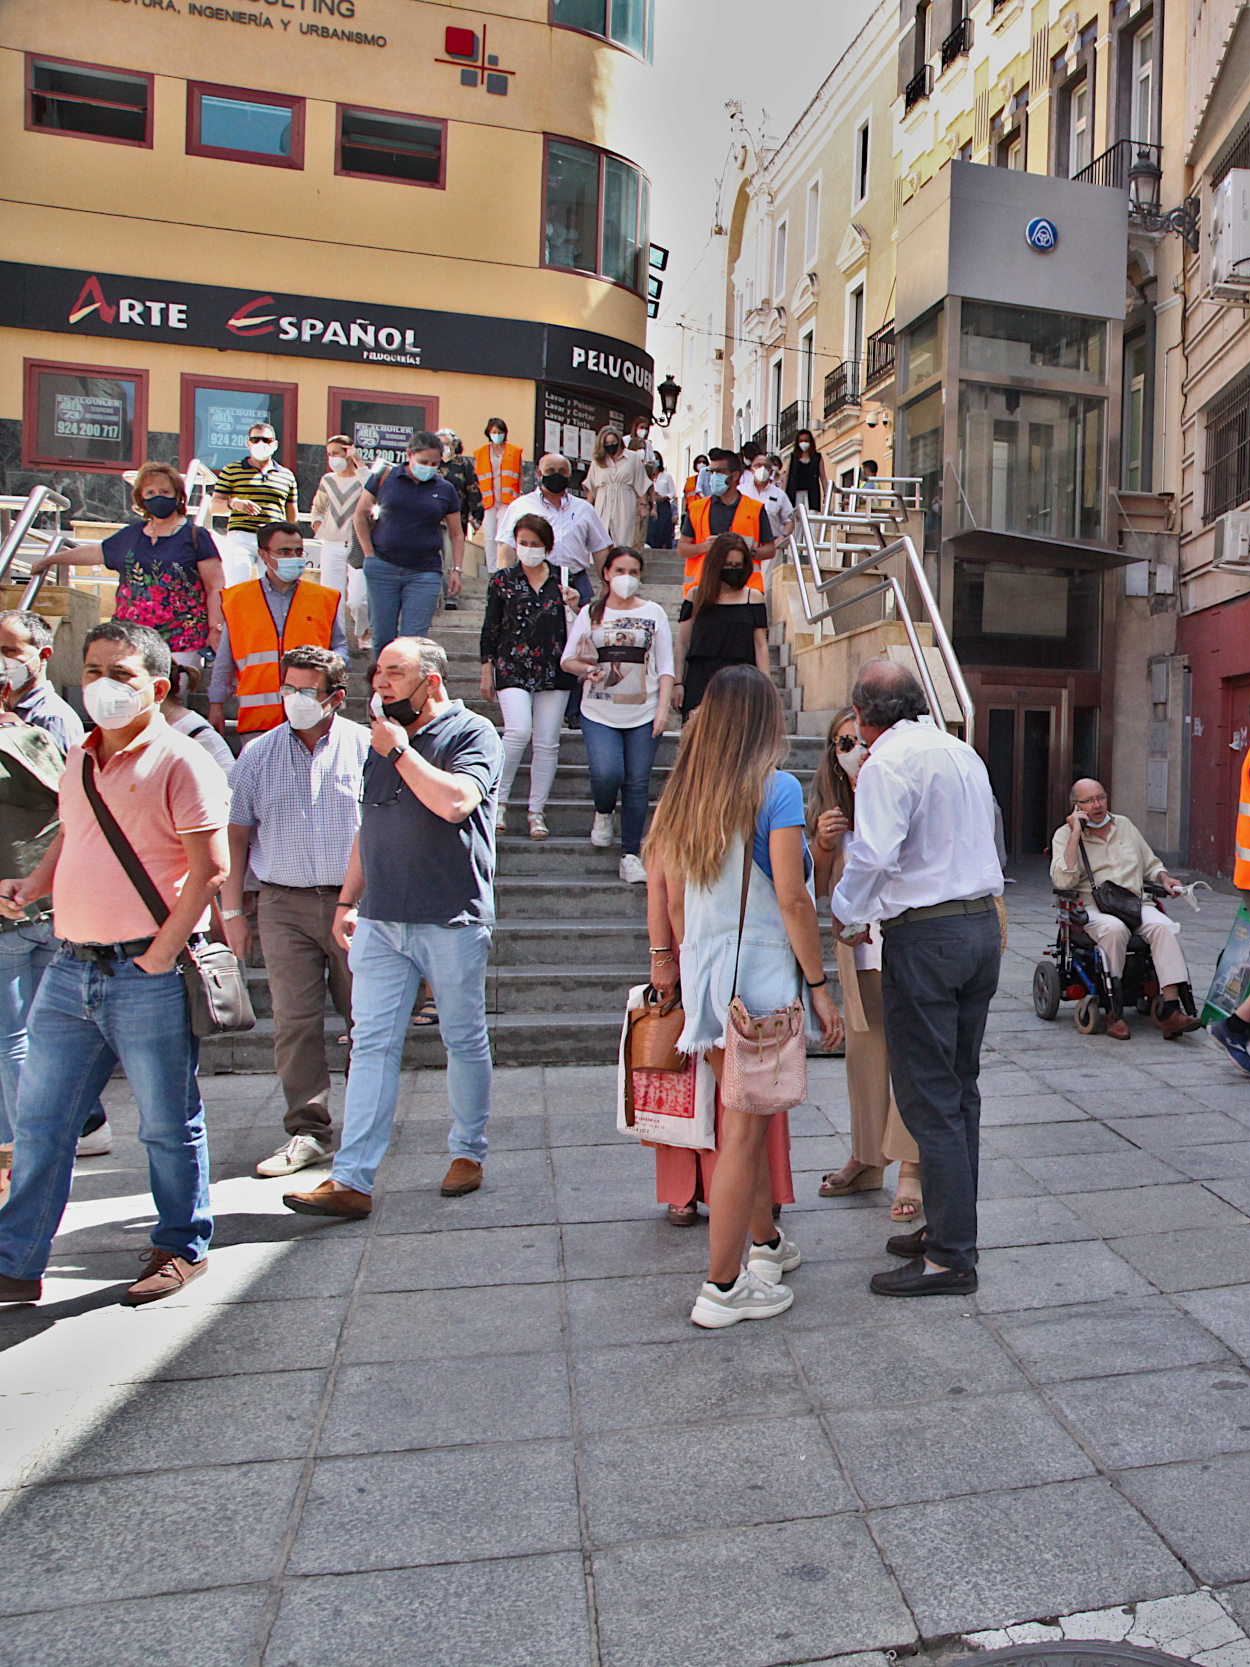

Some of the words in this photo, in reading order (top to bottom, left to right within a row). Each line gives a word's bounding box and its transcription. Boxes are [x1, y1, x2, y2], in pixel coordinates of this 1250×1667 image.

[188, 3, 273, 29] INGENIERÍA
[280, 19, 291, 31] Y
[299, 22, 387, 48] URBANISMO
[68, 275, 188, 329] ARTE
[225, 295, 422, 354] ESPAÑOL
[73, 398, 120, 407] ALQUILER
[545, 391, 565, 403] Lavar
[573, 400, 595, 412] Peinar
[61, 410, 80, 419] 73
[226, 409, 269, 418] ALQUILER
[545, 400, 565, 413] Lavar
[572, 408, 595, 421] Cortar
[213, 421, 231, 431] 73
[544, 410, 565, 423] Lavar
[572, 418, 591, 429] Tinte
[57, 421, 78, 435] 924
[79, 422, 101, 437] 200
[101, 424, 119, 438] 717
[371, 425, 412, 434] ALQUILER
[210, 432, 230, 445] 924
[359, 437, 376, 446] 73
